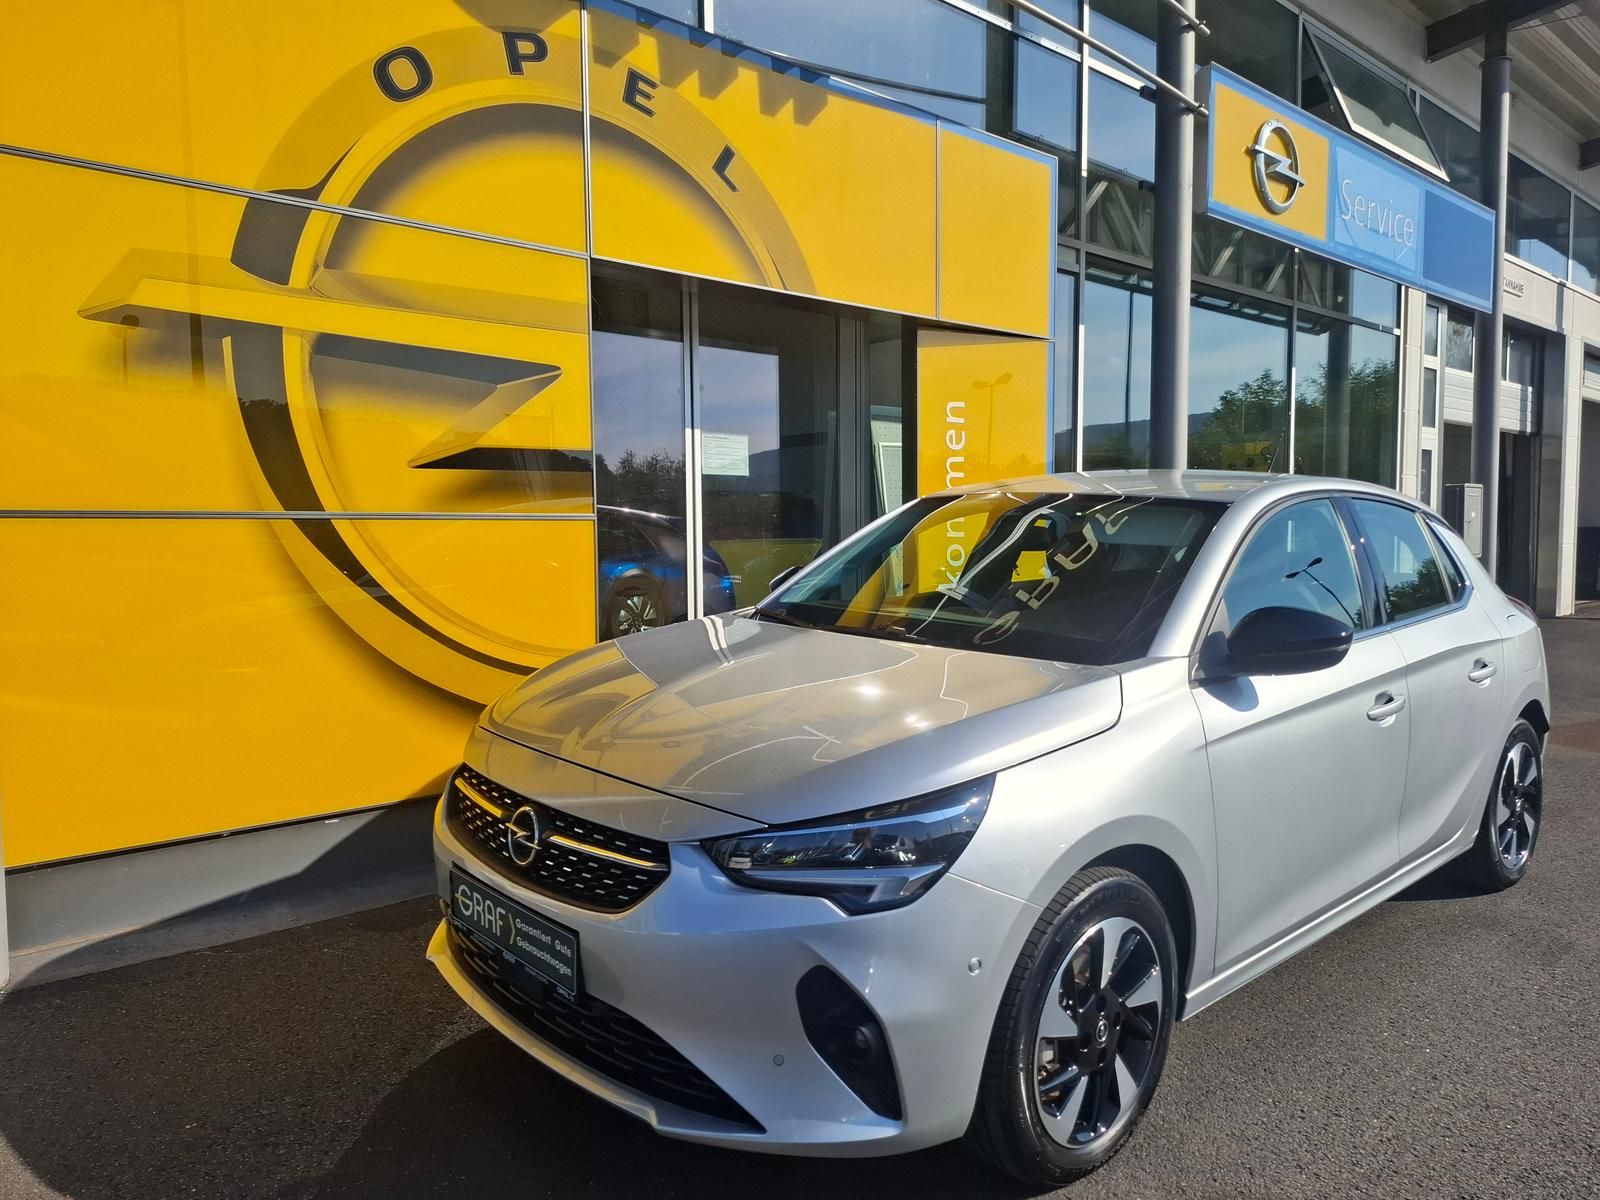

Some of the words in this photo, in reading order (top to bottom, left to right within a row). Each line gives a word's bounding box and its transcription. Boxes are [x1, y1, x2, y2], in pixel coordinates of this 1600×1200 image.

[373, 32, 740, 193] OPEL
[1340, 177, 1415, 246] Service
[455, 885, 506, 937] GRAF
[515, 918, 552, 944] Garantiert
[554, 940, 572, 958] Gute
[516, 936, 572, 977] Gebrauchtwagen
